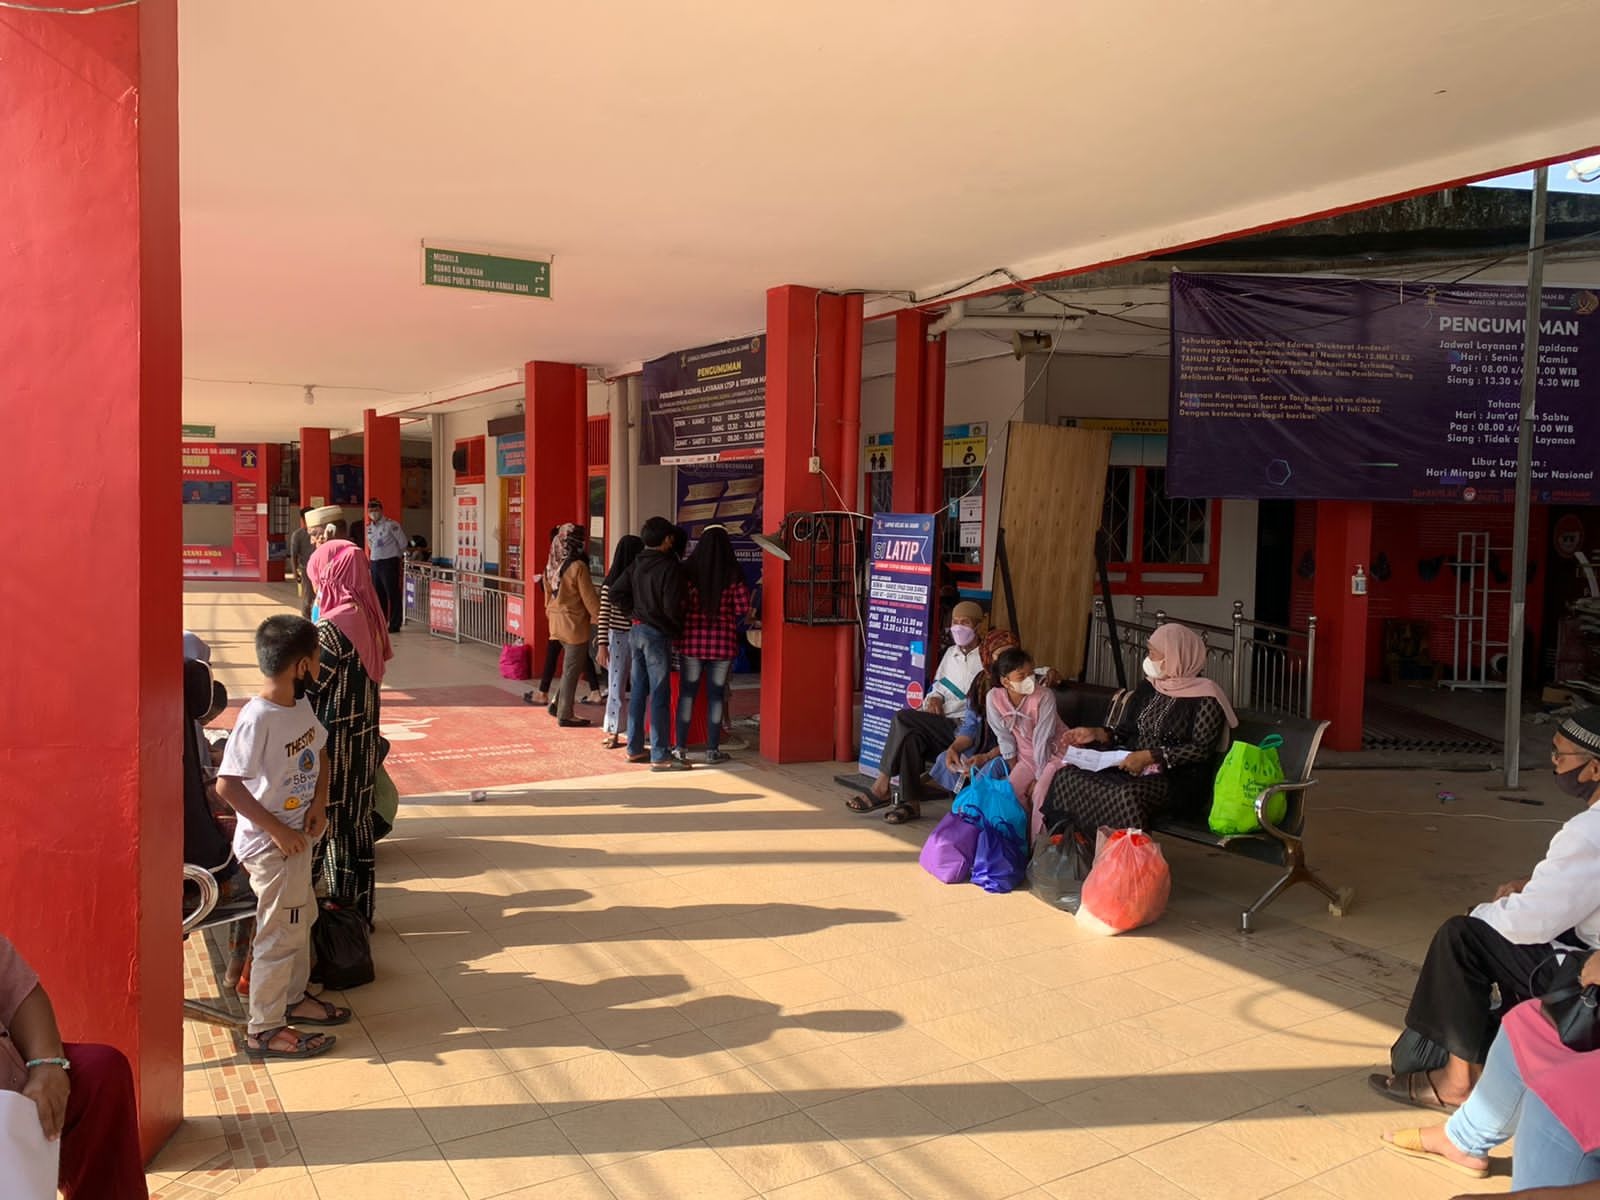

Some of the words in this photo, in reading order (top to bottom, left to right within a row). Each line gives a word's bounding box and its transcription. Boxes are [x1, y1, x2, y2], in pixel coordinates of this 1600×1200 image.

[1181, 336, 1232, 346] Sehubungan
[1440, 340, 1474, 349] Jadwal
[1477, 341, 1518, 352] Layanan
[1460, 352, 1482, 361] Hari
[1491, 353, 1518, 362] Senin
[1539, 355, 1569, 364] Kamis
[696, 360, 742, 377] PENGUMUMAN
[1180, 364, 1214, 373] Layanan
[1216, 365, 1260, 375] Kunjungan
[1450, 364, 1472, 374] Pagi
[1481, 365, 1508, 374] 08.00
[1535, 366, 1556, 375] 1.00
[1559, 367, 1577, 376] WIB
[1447, 375, 1474, 386] Siang
[1485, 376, 1511, 385] 13.30
[1538, 378, 1558, 387] 4.30
[1561, 379, 1580, 388] WIB
[1180, 392, 1213, 401] Layanan
[1215, 392, 1258, 402] Kunjungan
[1259, 393, 1287, 401] Secara
[1179, 408, 1210, 418] Dengan
[1361, 406, 1381, 414] 2022
[1455, 410, 1477, 419] Hari
[1542, 412, 1570, 422] Sabtu
[1449, 422, 1468, 432] Pag
[1477, 423, 1505, 432] 08.00
[1532, 423, 1553, 433] 1.00
[1555, 424, 1574, 433] WIB
[1447, 433, 1474, 445] Siang
[1484, 434, 1510, 444] Tidak
[1535, 435, 1576, 447] Layanan
[1471, 457, 1497, 466] Libur
[1426, 468, 1447, 477] Hari
[1449, 468, 1487, 480] Minggu
[1489, 469, 1496, 478] &
[1551, 470, 1594, 479] Nasional
[885, 540, 919, 561] LATIP
